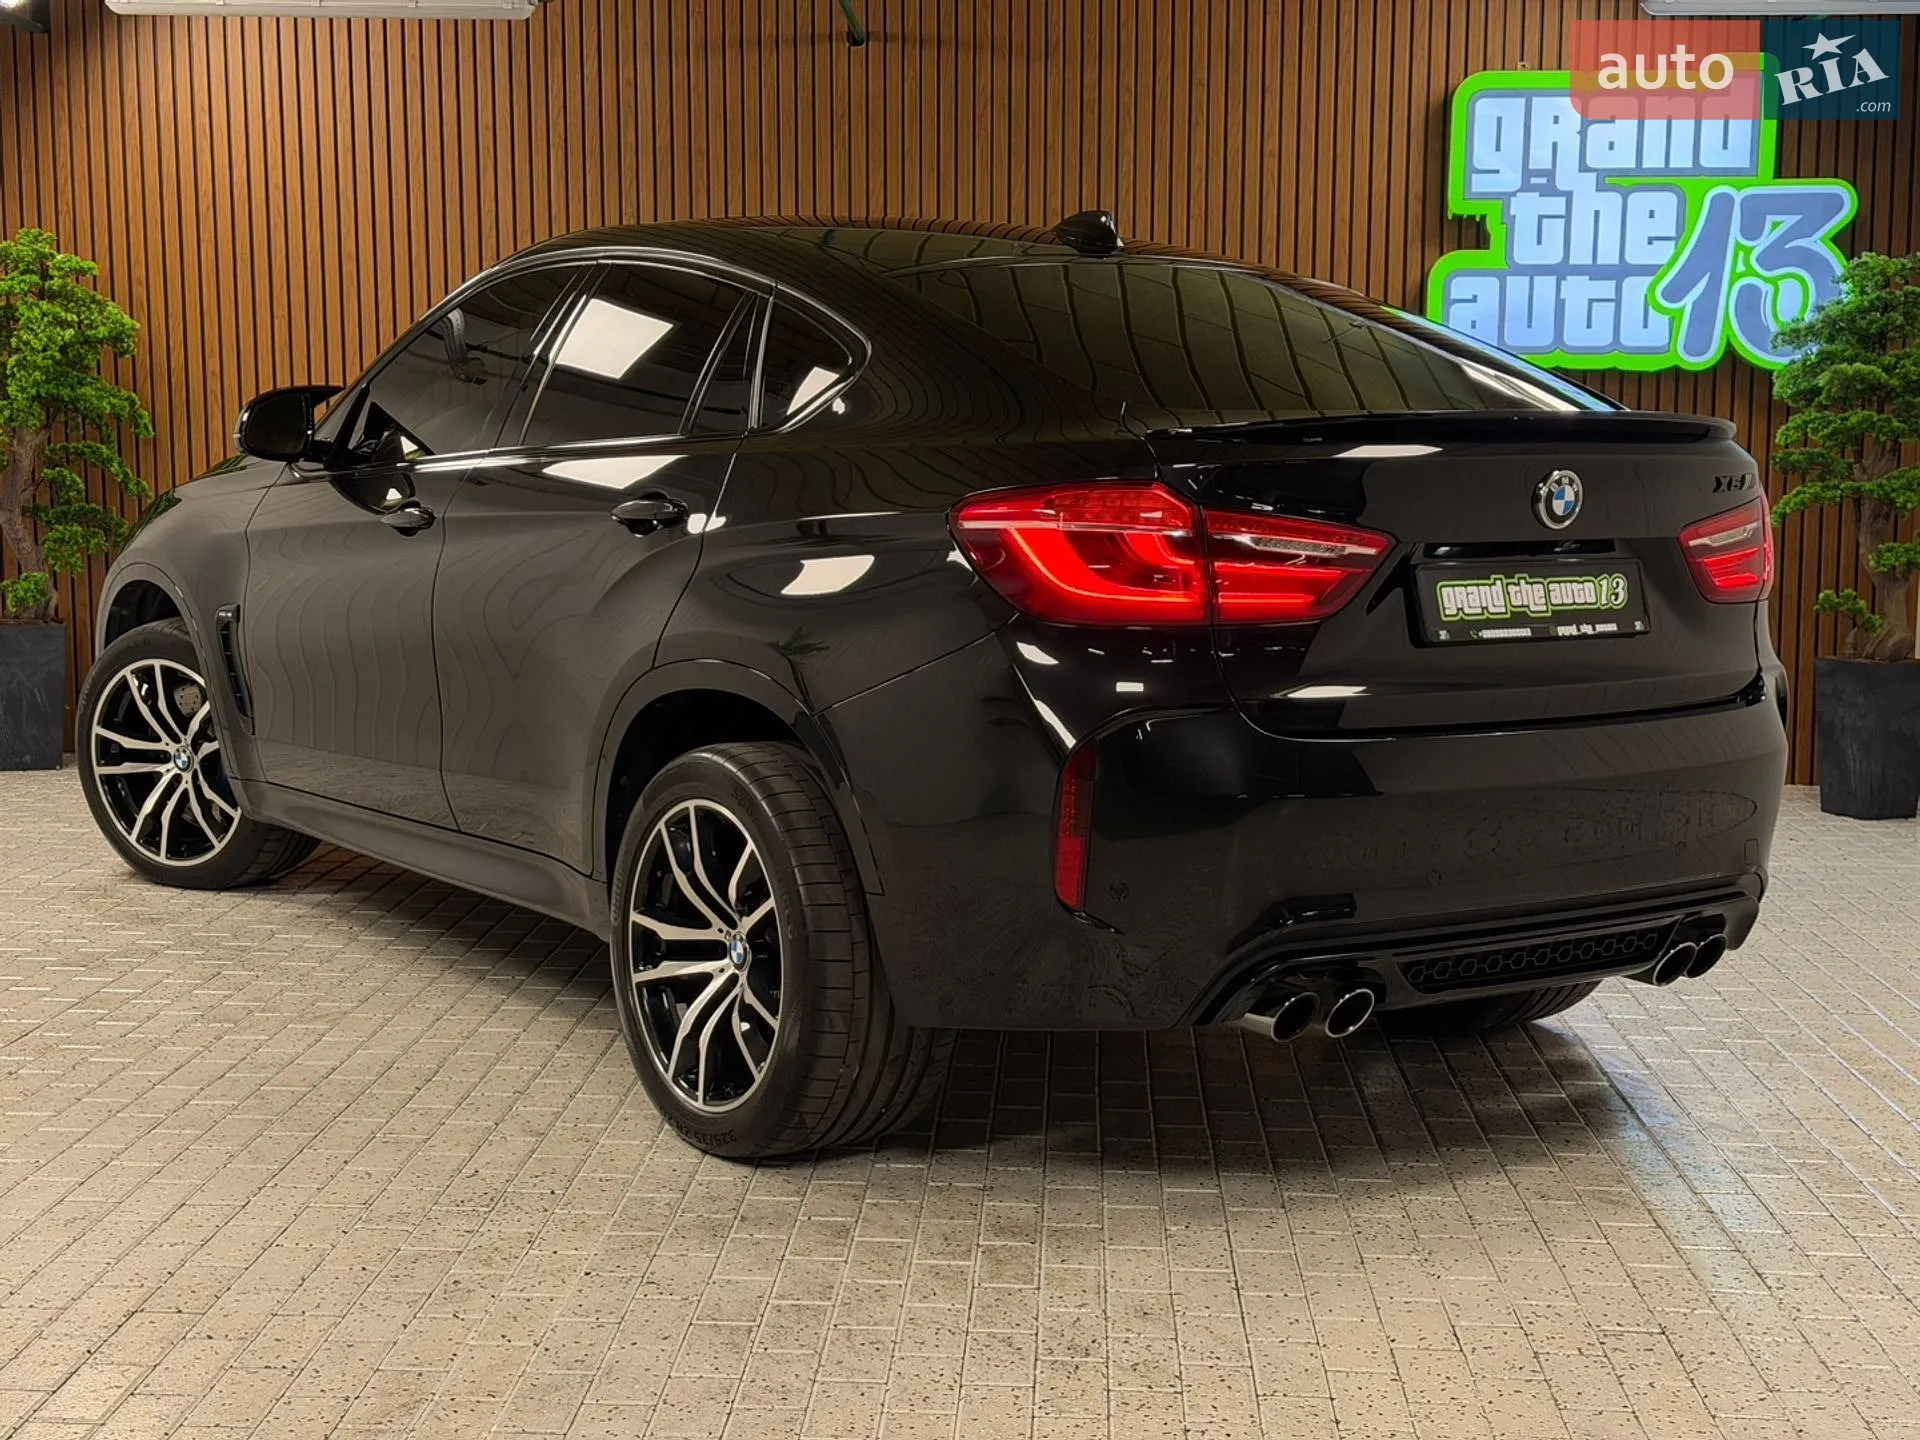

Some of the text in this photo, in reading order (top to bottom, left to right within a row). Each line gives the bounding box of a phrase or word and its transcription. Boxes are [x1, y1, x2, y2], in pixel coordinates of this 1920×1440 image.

[1510, 172, 1679, 266] the
[1448, 186, 1851, 362] auto 13
[1508, 579, 1548, 612] the
[1549, 580, 1597, 605] auto
[1599, 576, 1626, 606] 13
